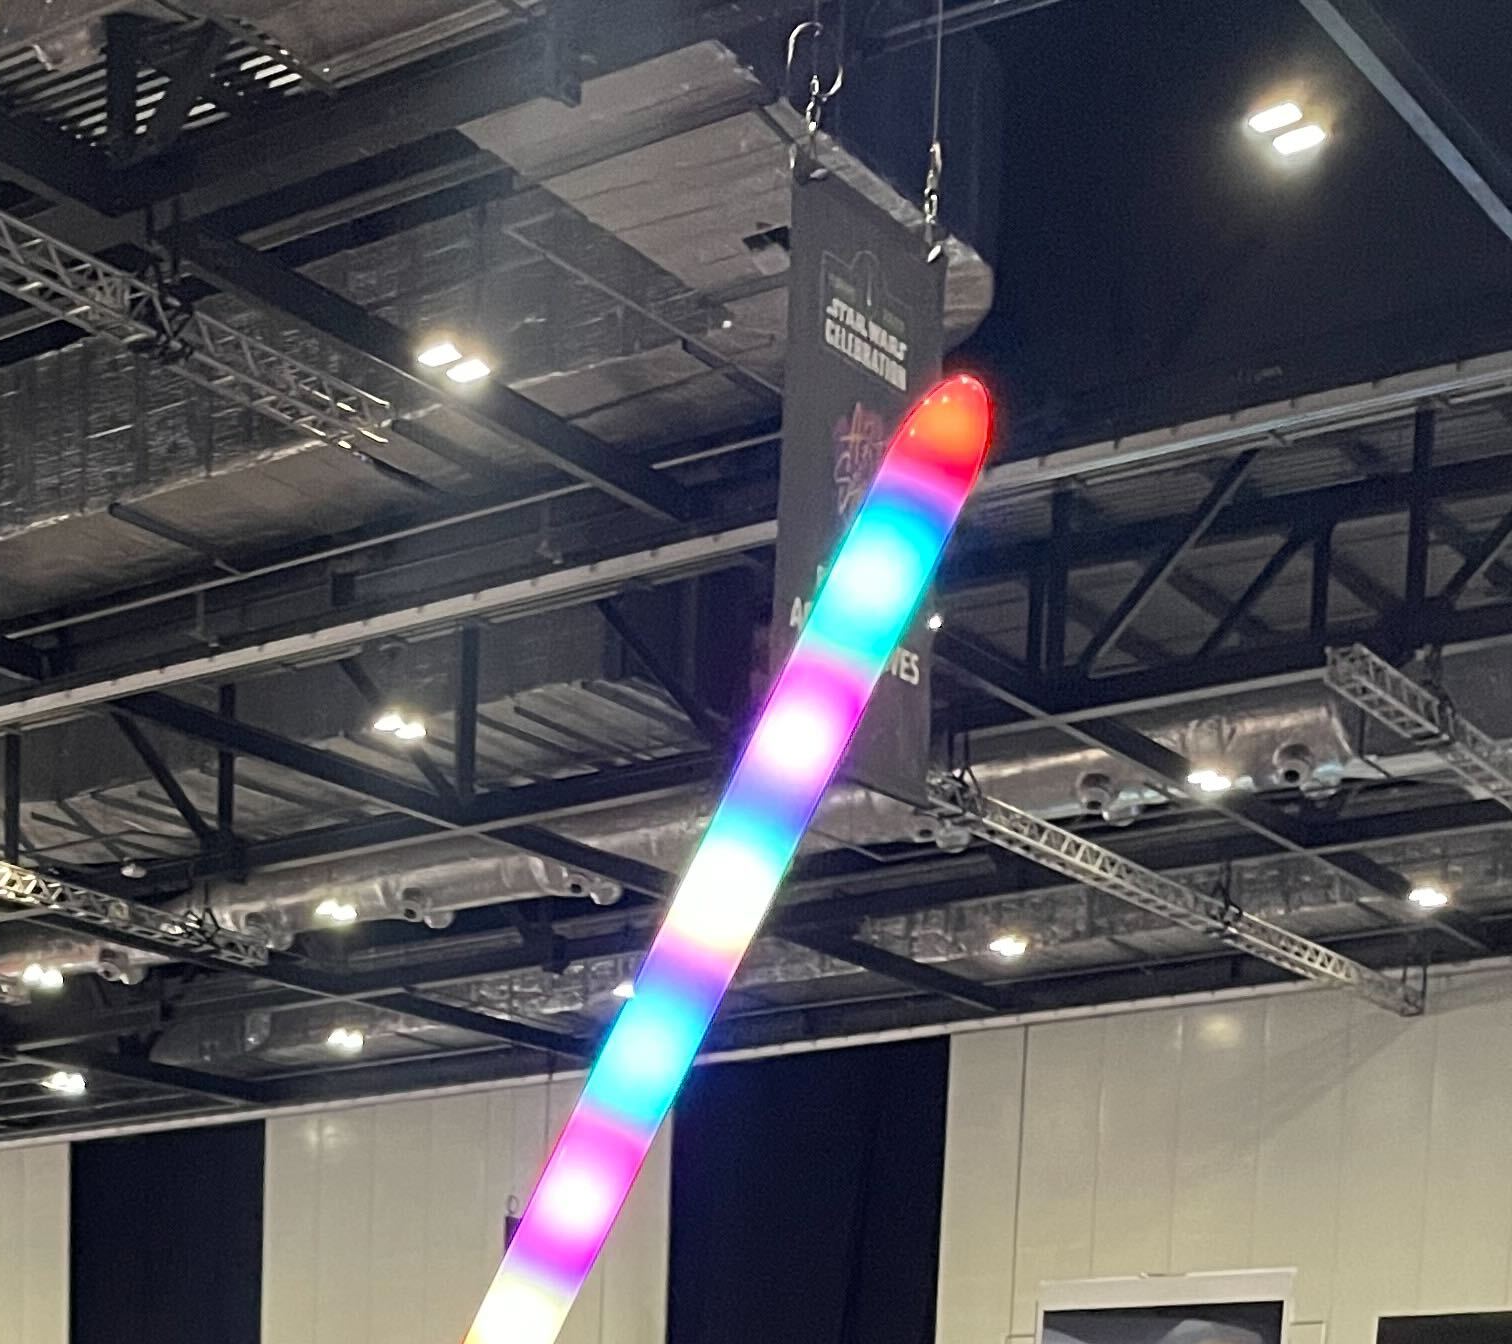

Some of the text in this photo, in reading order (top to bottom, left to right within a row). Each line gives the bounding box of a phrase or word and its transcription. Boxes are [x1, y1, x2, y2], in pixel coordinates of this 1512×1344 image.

[824, 317, 908, 392] CELEBRATION
[826, 298, 868, 338] STAR
[868, 319, 908, 361] WARS
